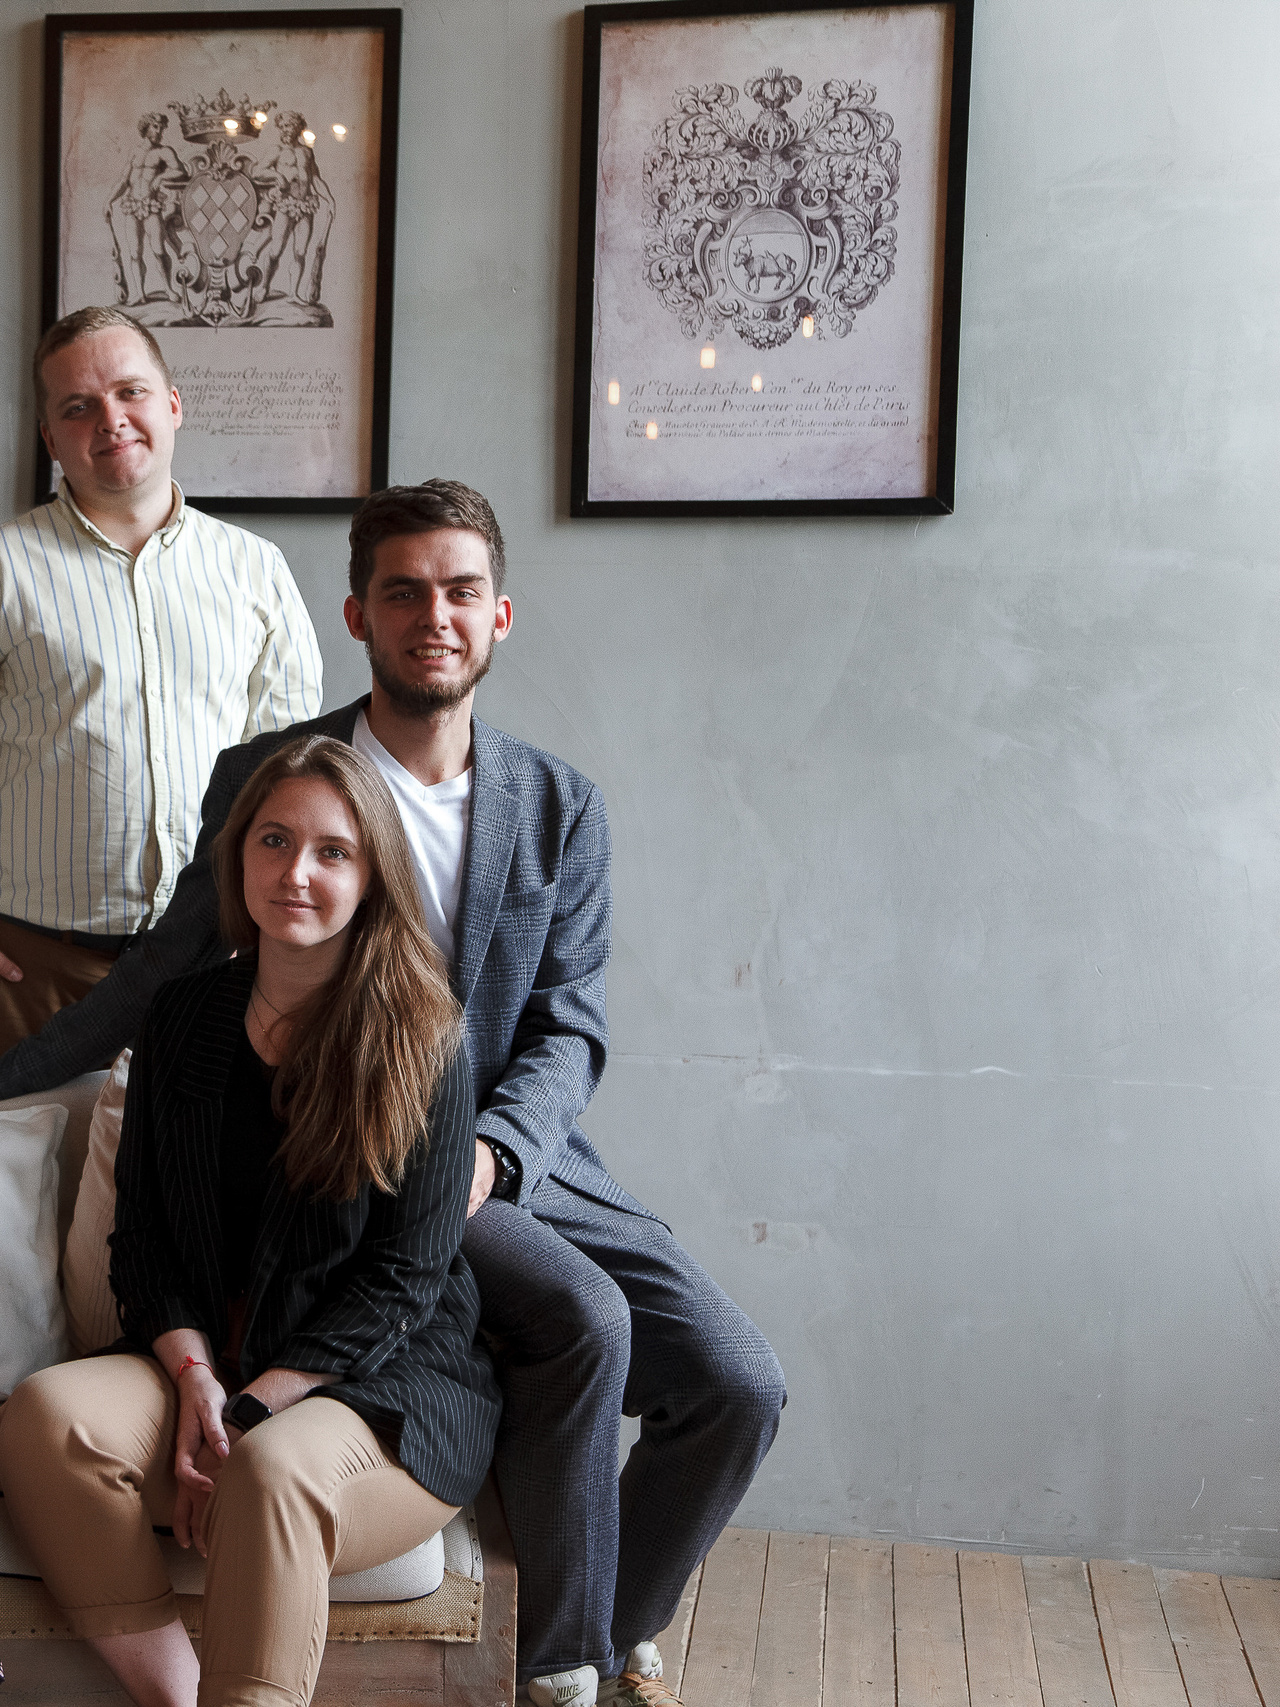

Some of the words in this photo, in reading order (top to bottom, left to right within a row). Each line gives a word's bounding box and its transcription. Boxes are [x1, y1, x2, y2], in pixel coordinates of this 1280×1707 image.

[710, 381, 761, 395] Rober
[802, 380, 822, 394] du
[825, 380, 853, 394] Roy
[855, 384, 872, 394] en
[874, 384, 897, 394] ses
[692, 403, 718, 413] son
[720, 398, 794, 413] Procureur
[795, 403, 814, 412] au
[853, 395, 871, 411] de
[871, 396, 911, 412] Paris
[555, 1684, 580, 1698] NIKE
